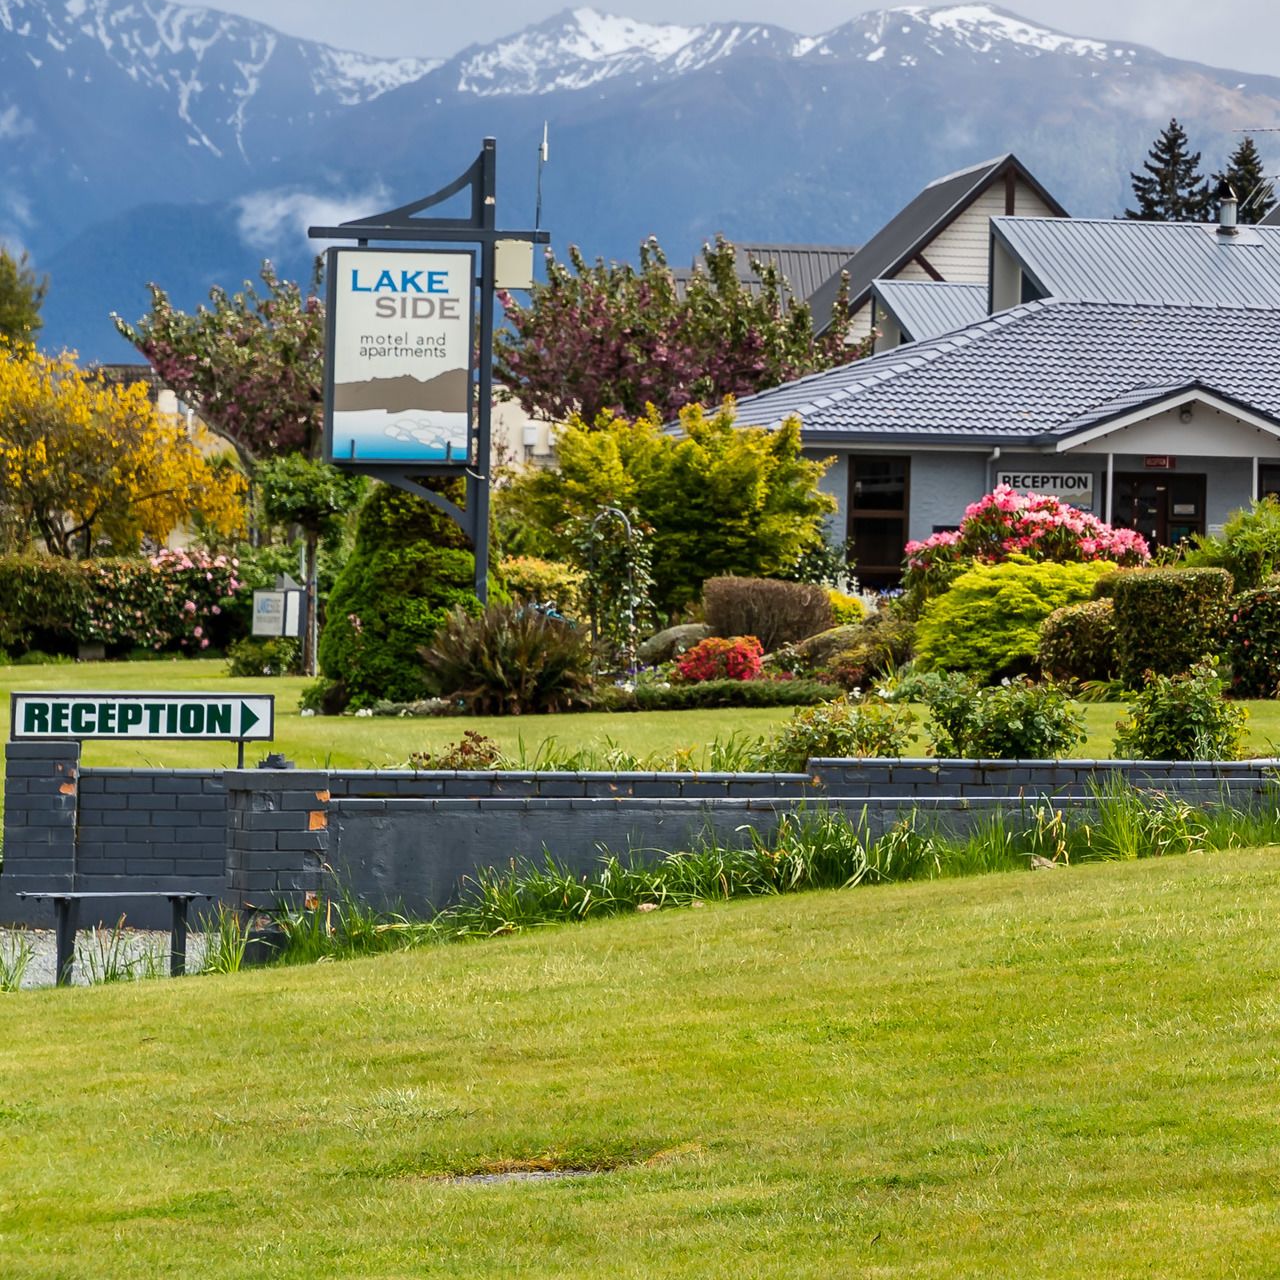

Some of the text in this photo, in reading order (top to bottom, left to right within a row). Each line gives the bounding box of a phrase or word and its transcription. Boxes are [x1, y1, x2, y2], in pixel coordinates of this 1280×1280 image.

[351, 268, 449, 294] LAKE
[375, 296, 461, 320] SIDE
[360, 331, 446, 346] motel and
[359, 346, 447, 360] apartments
[1002, 475, 1089, 489] RECEPTION
[23, 702, 232, 734] RECEPTION
